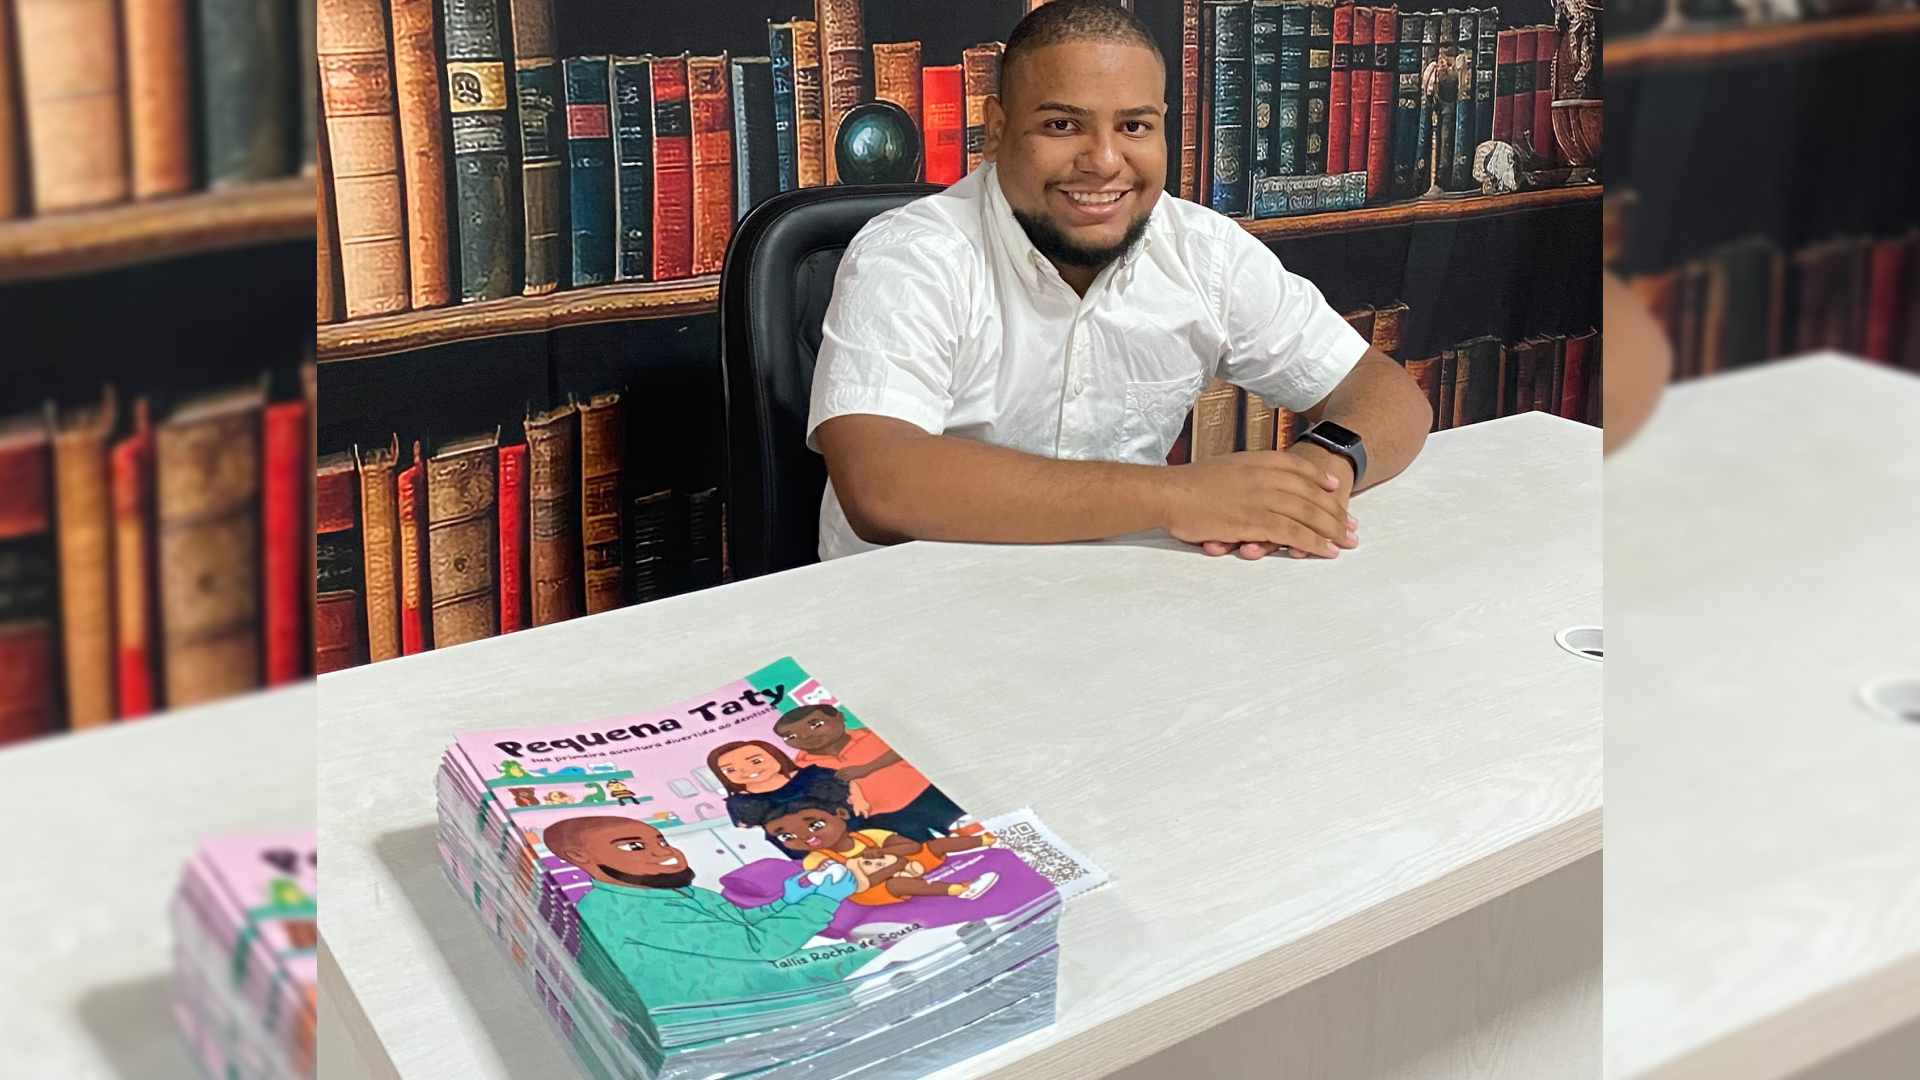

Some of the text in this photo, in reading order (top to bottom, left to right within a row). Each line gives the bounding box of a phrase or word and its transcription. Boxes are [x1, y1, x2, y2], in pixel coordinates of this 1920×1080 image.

[494, 684, 785, 757] Pequena Taty
[554, 752, 606, 763] primeira
[609, 742, 662, 755] aventura
[665, 728, 716, 745] divertida
[719, 722, 731, 730] ao
[734, 704, 778, 725] dentista
[770, 922, 922, 969] Tallis Rocha de Sousa
